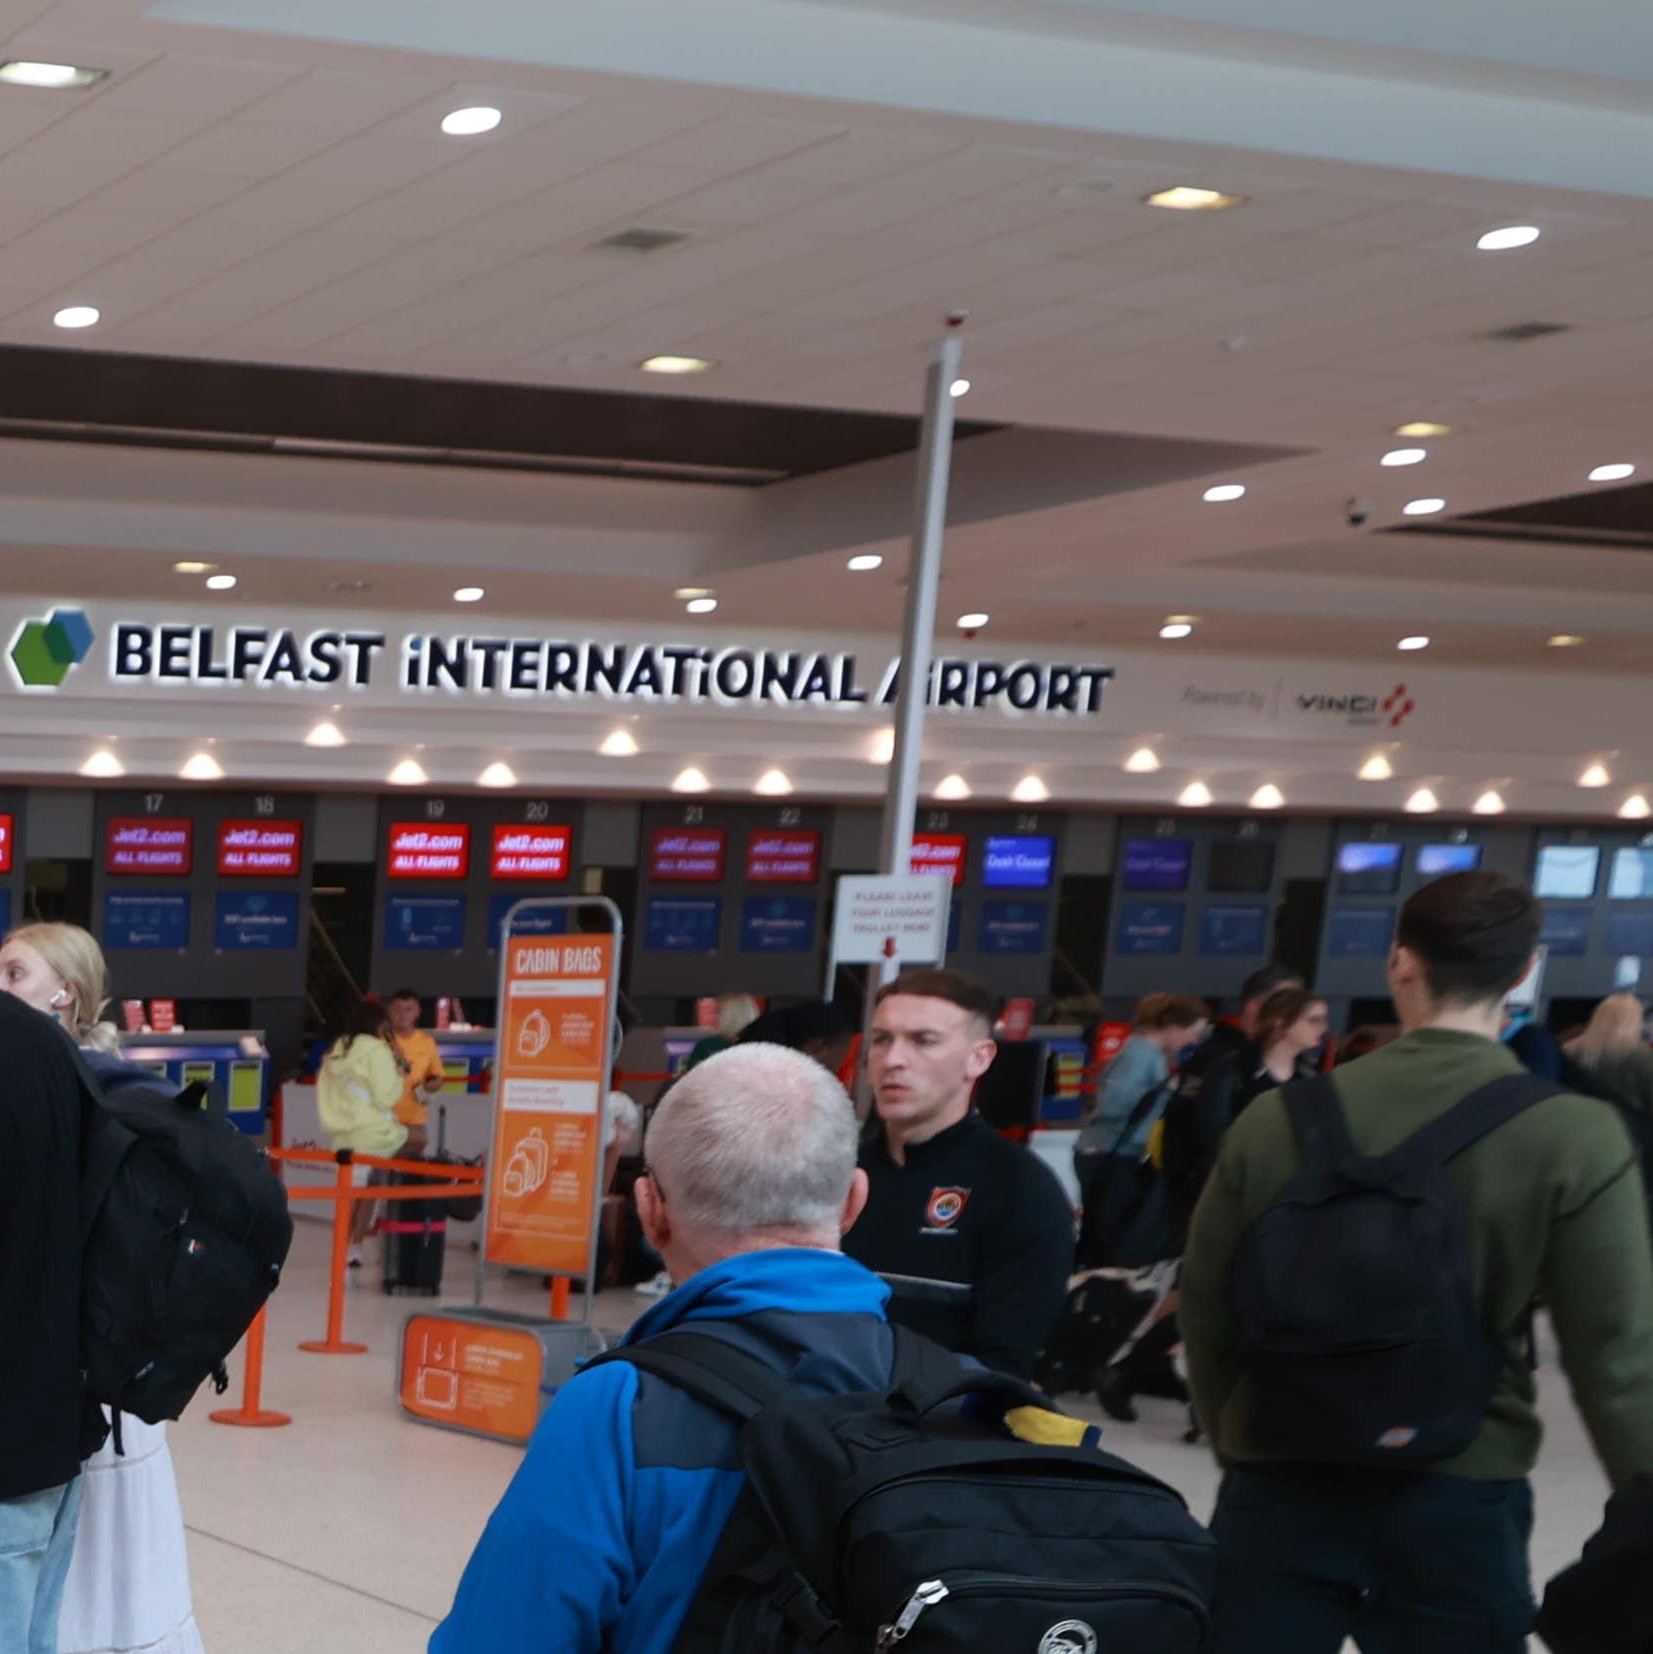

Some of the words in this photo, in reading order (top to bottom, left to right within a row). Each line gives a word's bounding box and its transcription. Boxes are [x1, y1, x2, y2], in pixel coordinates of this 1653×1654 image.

[114, 623, 385, 686] BELFAST
[1296, 693, 1378, 713] VINCI
[145, 794, 163, 813] 17
[426, 800, 445, 818] 19
[526, 801, 549, 820] 20
[113, 828, 186, 845] Jet2.com
[224, 829, 295, 847] Jet2.com
[394, 833, 463, 850] Jet2.com
[497, 835, 565, 852] Jet2.com
[516, 948, 559, 974] CABIN
[564, 946, 602, 974] BAGS
